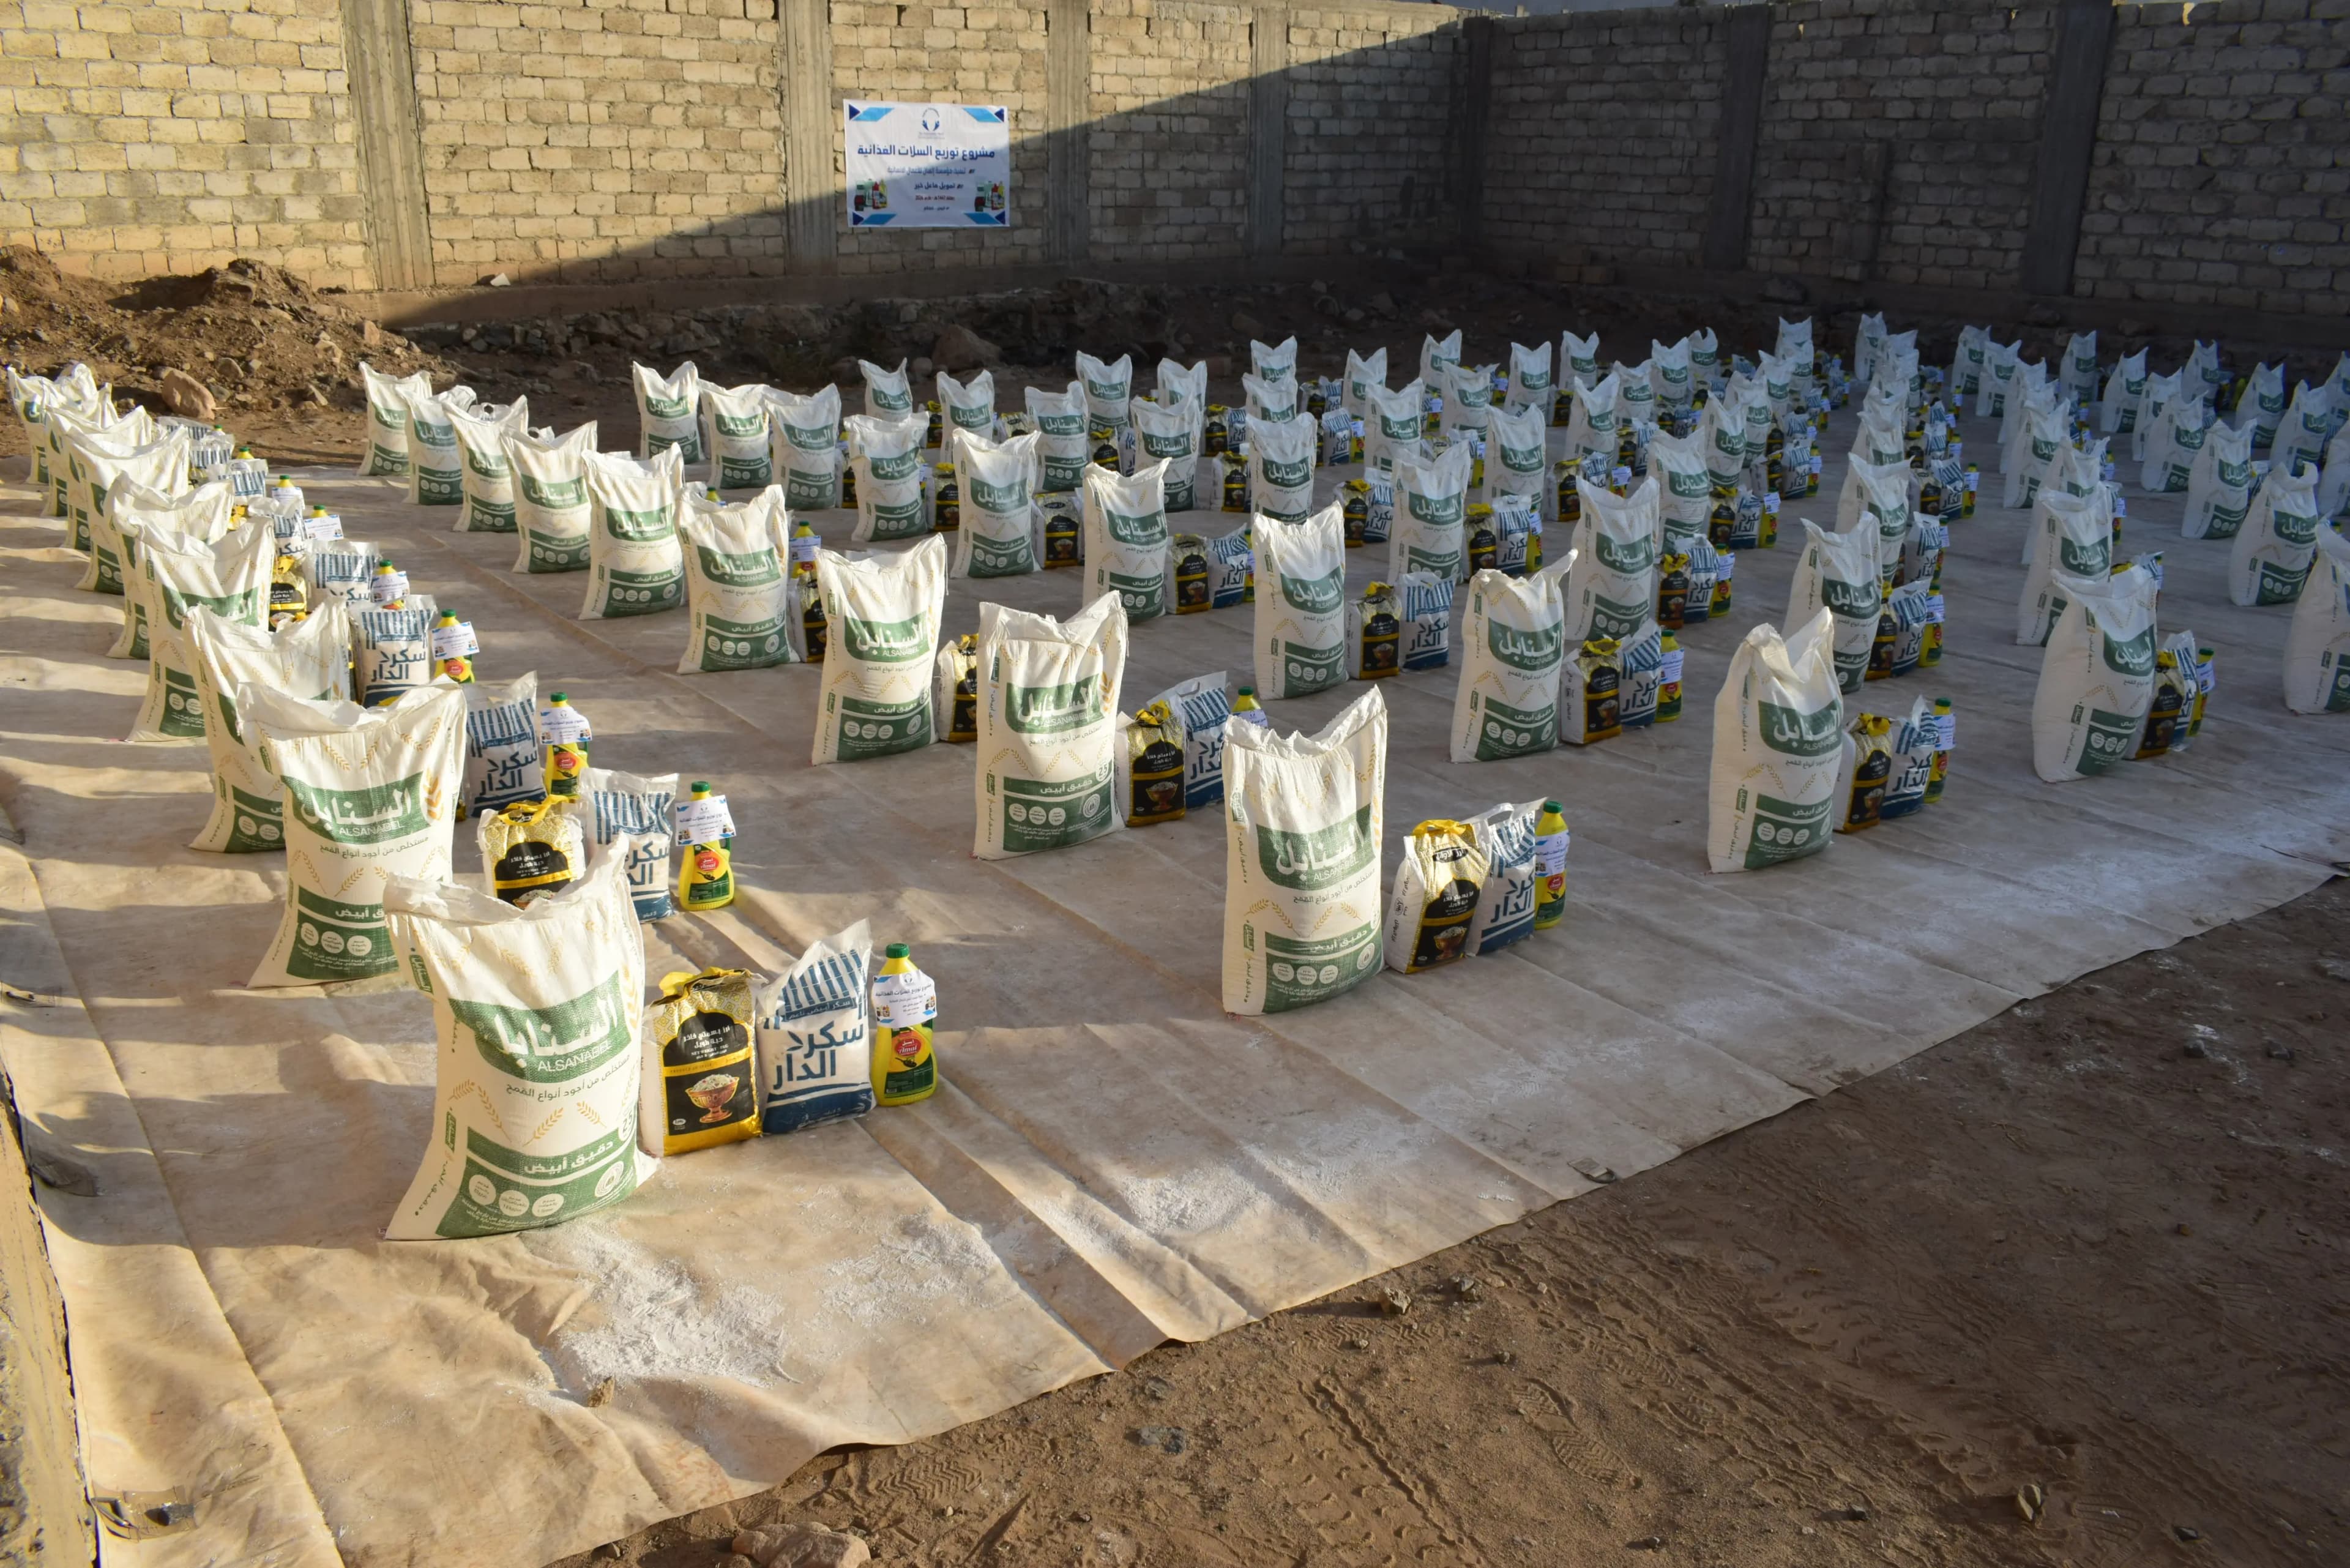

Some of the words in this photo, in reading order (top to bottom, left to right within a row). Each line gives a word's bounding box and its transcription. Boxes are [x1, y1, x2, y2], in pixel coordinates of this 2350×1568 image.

[898, 145, 933, 157] السلات
[934, 147, 958, 159] توزيع
[961, 146, 995, 160] مشروع
[651, 398, 686, 414] السنابل
[955, 406, 990, 423] السنابل
[722, 417, 759, 432] السنابل
[1045, 417, 1083, 432] السنابل
[1385, 419, 1417, 436] السنابل
[792, 431, 831, 447] السنابل
[1145, 436, 1188, 454] السنابل
[1507, 447, 1543, 466] السنابل
[1269, 461, 1308, 481] السنابل
[530, 482, 581, 501] السنابل
[977, 483, 1026, 507] السنابل
[1416, 495, 1457, 517] السنابل
[616, 512, 668, 534] السنابل
[1117, 513, 1165, 540] السنابل
[1603, 543, 1650, 567] السنابل
[710, 554, 772, 580] السنابل
[1292, 576, 1341, 607] السنابل
[753, 622, 773, 631] دقيق
[1426, 618, 1449, 637] سكر
[856, 621, 923, 655] السنابل
[1409, 632, 1440, 651] الدار
[1499, 631, 1560, 661] السنابل
[390, 648, 425, 667] سكر
[882, 646, 919, 657] ALSANABEL
[1312, 649, 1328, 659] أبيض
[371, 663, 409, 682] الدار
[875, 705, 895, 714] أبيض
[897, 703, 917, 713] دقيق
[1018, 684, 1092, 726] السنابل
[1622, 690, 1654, 712] الدار
[1044, 712, 1088, 726] ALSANABEL
[1515, 712, 1534, 722] أبيض
[1535, 708, 1551, 720] دقيق
[500, 750, 538, 777] سكر
[1099, 765, 1107, 776] 25
[480, 769, 523, 796] الدار
[1040, 785, 1065, 794] أبيض
[1067, 779, 1092, 792] دقيق
[301, 788, 411, 831] السنابل
[1793, 807, 1814, 817] أبيض
[339, 821, 403, 837] ALSANABEL
[320, 845, 339, 854] القمح
[342, 849, 360, 858] أنواع
[382, 847, 394, 856] من
[396, 837, 428, 853] مستخلص
[1276, 823, 1364, 881] السنابل
[629, 841, 669, 869] سكر
[627, 863, 653, 886] الد
[1313, 856, 1359, 881] ALSANABEL
[1354, 868, 1375, 887] مستخلص
[1316, 895, 1329, 905] أنواع
[1330, 888, 1342, 898] أجود
[335, 907, 369, 919] أبيض
[1491, 888, 1532, 923] الدار
[1310, 940, 1337, 952] أبيض
[1340, 930, 1367, 947] دقيق
[411, 955, 432, 994] السنابل
[684, 1033, 696, 1042] فاخر
[698, 1030, 721, 1040] بسمتي
[804, 1021, 864, 1059] سكر
[695, 1040, 710, 1048] طويل
[537, 1040, 612, 1072] ALSANABEL
[602, 1055, 630, 1081] مستخلص
[774, 1050, 836, 1090] الدار
[506, 1083, 534, 1097] القمح
[563, 1081, 584, 1097] أجود
[587, 1077, 599, 1089] من
[538, 1088, 560, 1102] أنواع
[622, 1113, 633, 1133] 25
[571, 1142, 613, 1168] دقيق
[524, 1157, 567, 1176] أبيض
